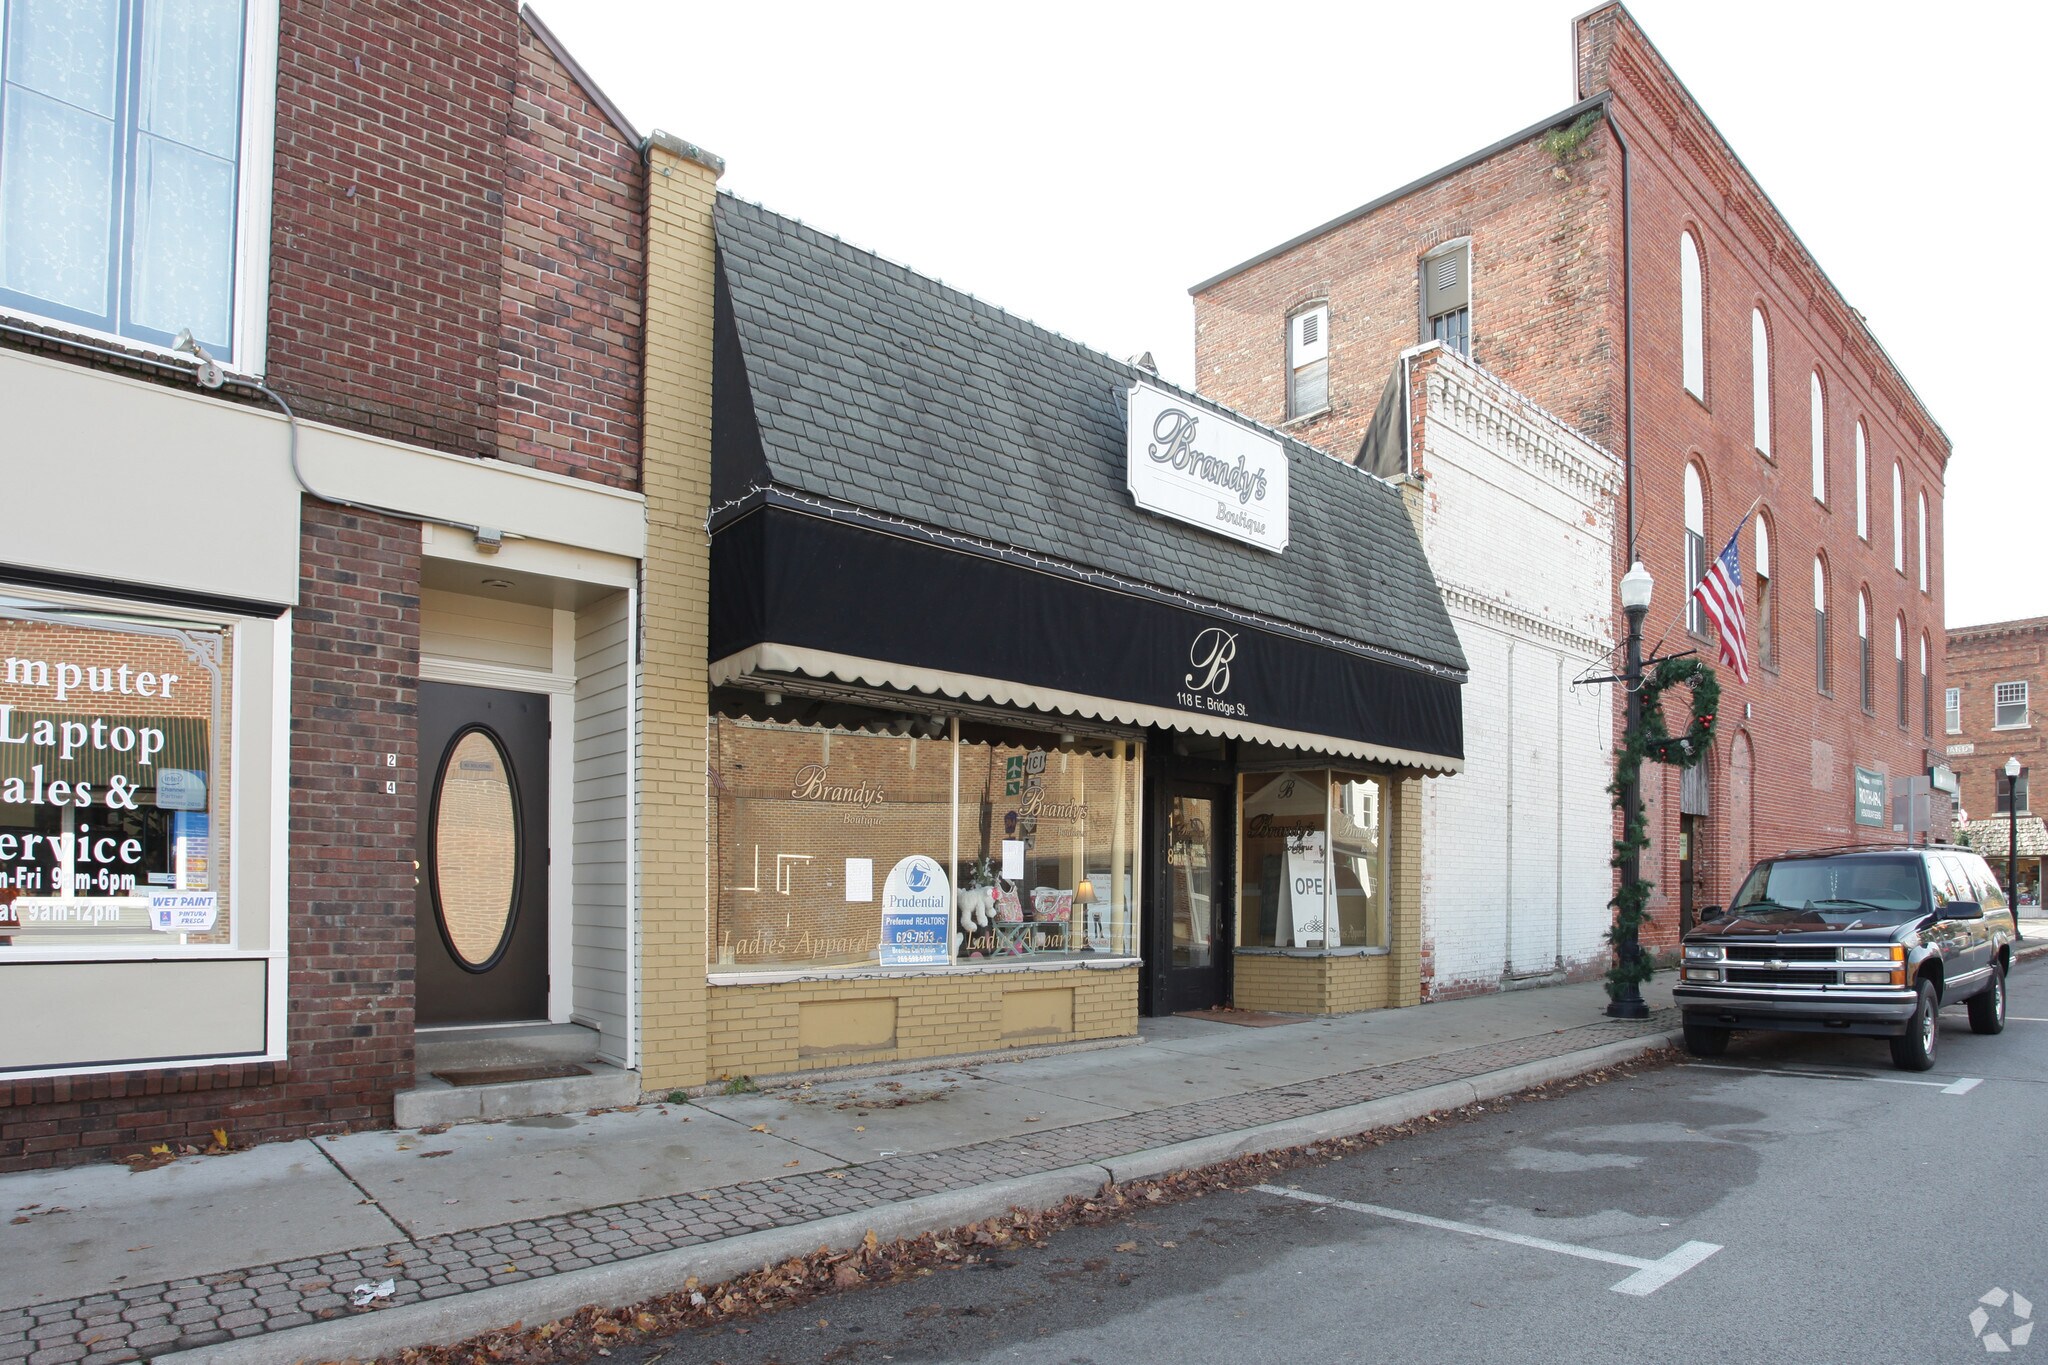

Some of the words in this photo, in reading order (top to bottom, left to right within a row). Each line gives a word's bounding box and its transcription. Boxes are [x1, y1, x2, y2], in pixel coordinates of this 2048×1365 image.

[1148, 408, 1267, 504] Brandy's
[1216, 501, 1266, 535] Boutique
[4, 656, 179, 701] mputer
[1185, 627, 1238, 695] B
[1176, 691, 1193, 706] 118
[1195, 695, 1205, 708] E.
[1207, 697, 1235, 716] Bridge
[1236, 703, 1249, 716] St.
[0, 704, 165, 765] Laptop
[3, 764, 93, 808] ales
[105, 774, 140, 810] &
[791, 764, 885, 810] Brandy's
[1019, 785, 1088, 824] Brandy's
[843, 813, 883, 828] Boutique
[153, 897, 178, 906] WET
[180, 897, 213, 906] PAINT
[890, 895, 944, 908] Prudential
[886, 917, 913, 926] Preferred
[724, 930, 786, 957] Ladies
[793, 929, 871, 959] Apparel
